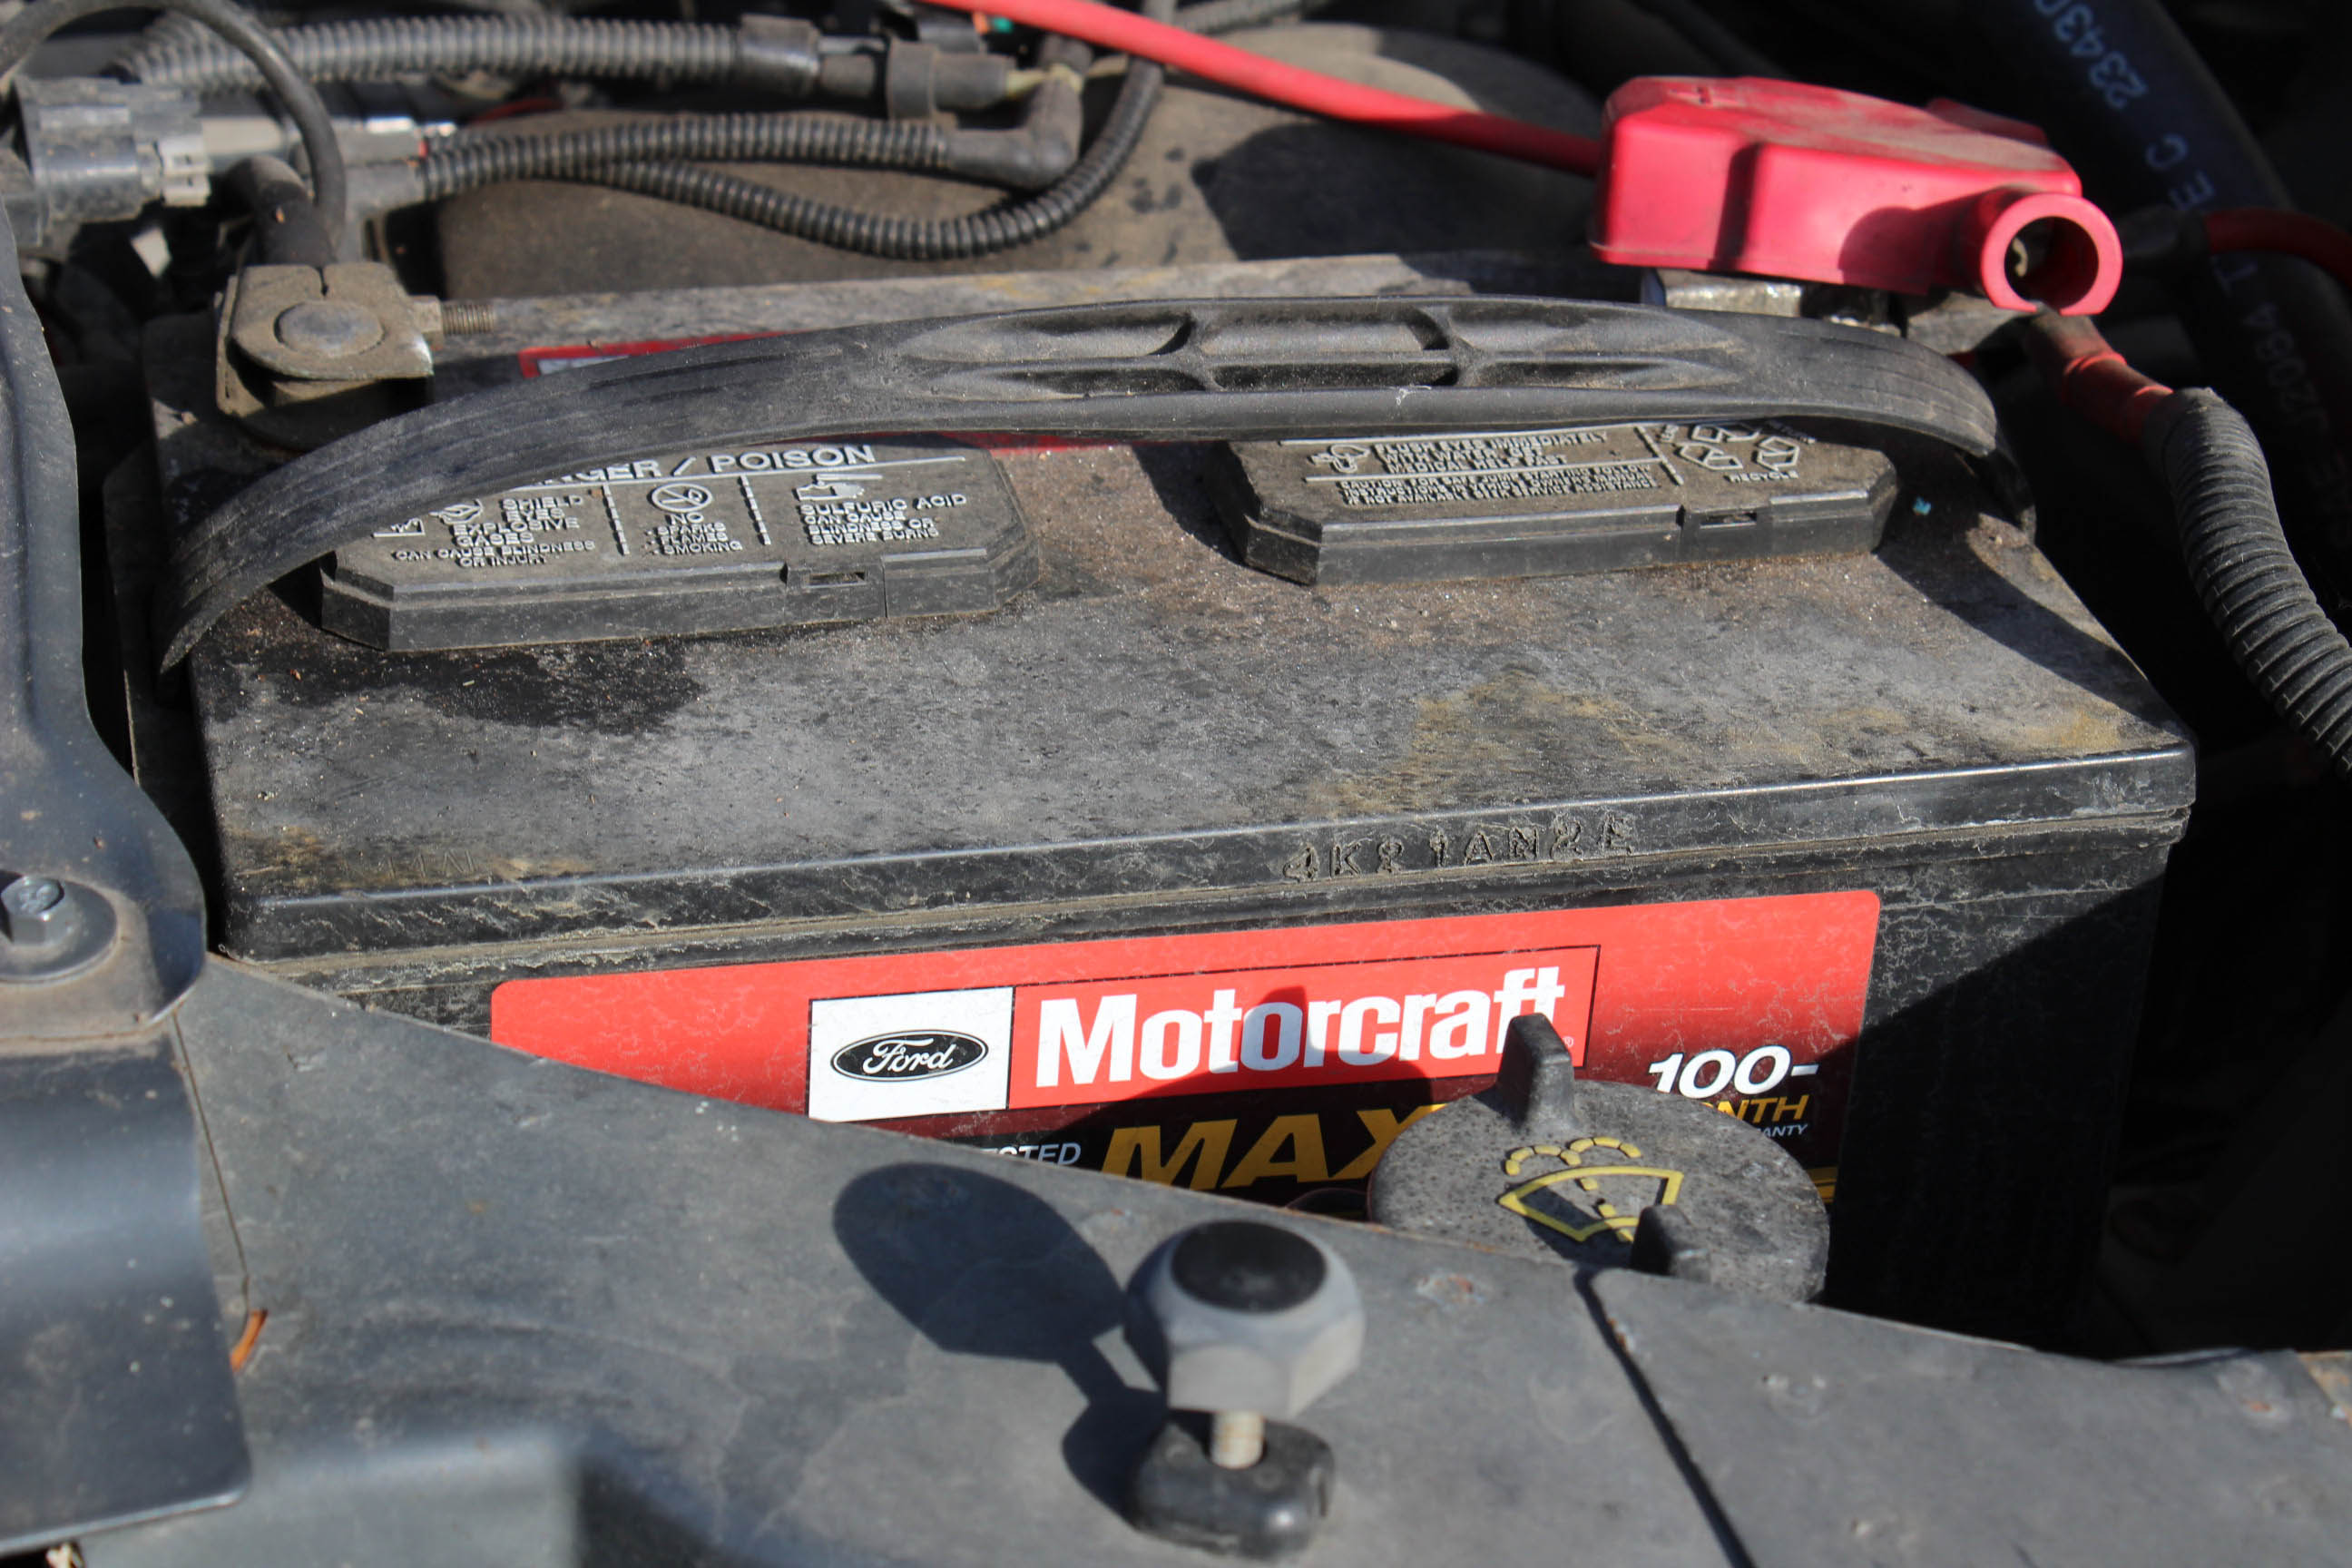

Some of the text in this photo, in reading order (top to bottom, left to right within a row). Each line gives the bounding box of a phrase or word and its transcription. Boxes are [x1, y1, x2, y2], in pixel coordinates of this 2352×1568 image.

[1375, 431, 1607, 455] FLUSH EYES IMMEDIATELY
[710, 445, 876, 473] POISON
[1382, 454, 1431, 466] WITH
[1508, 445, 1544, 457] GET
[1389, 455, 1568, 473] MEDICAL HELP FAST
[1728, 470, 1799, 483] RECYCLE
[501, 494, 584, 510] SHIELD
[799, 494, 967, 516] SULFURIC ACID
[506, 506, 566, 522] EYES
[671, 512, 704, 526] NO
[804, 510, 906, 525] CAN CAUSE
[456, 516, 581, 535] EXPLOSIVE
[657, 522, 726, 535] SPARKS
[808, 516, 936, 535] BLINDNESS OR
[456, 531, 534, 547] GASES
[661, 531, 729, 545] FLAMES
[812, 526, 940, 546] SEVERE BURNS
[396, 540, 596, 562] CAN CAUSE BLINDNESS
[664, 540, 743, 554] SMOKING
[460, 555, 486, 568] OR
[1036, 966, 1565, 1087] Motorcraft
[861, 1037, 955, 1075] Ford
